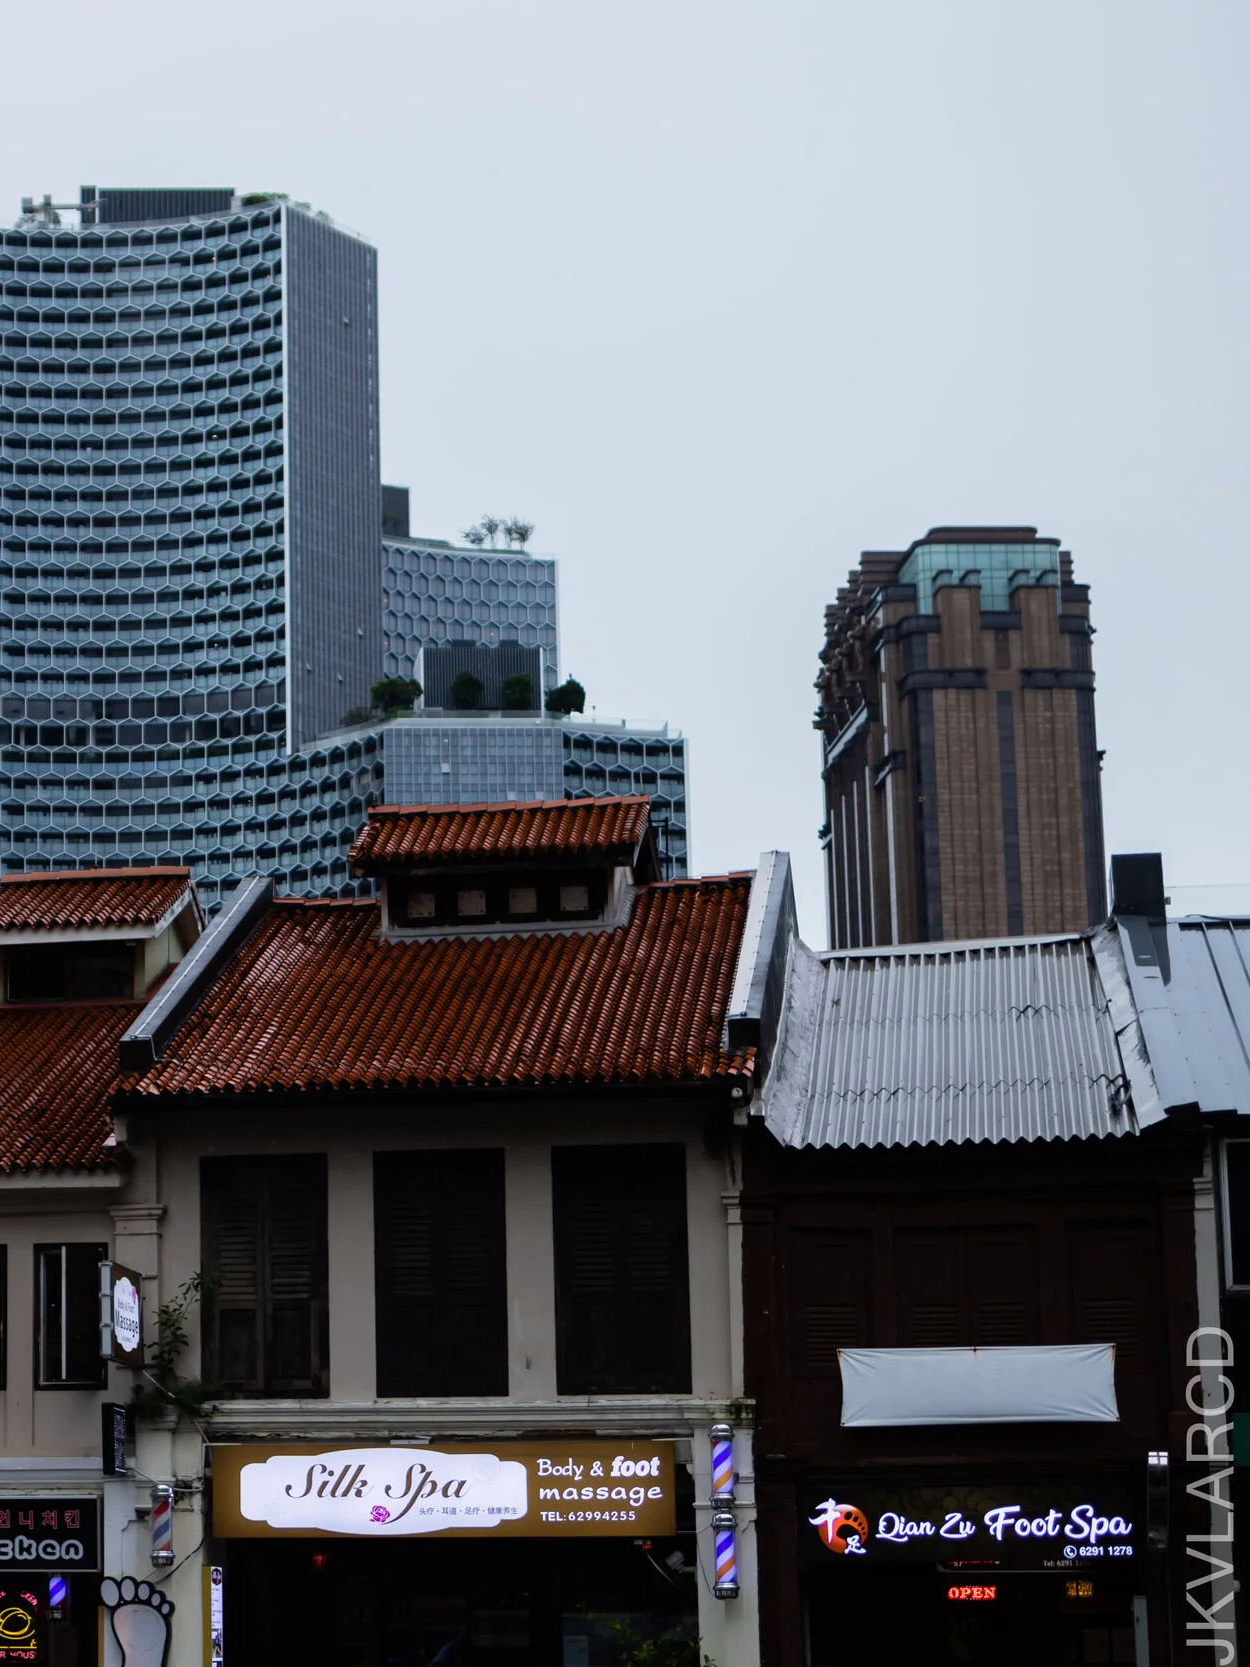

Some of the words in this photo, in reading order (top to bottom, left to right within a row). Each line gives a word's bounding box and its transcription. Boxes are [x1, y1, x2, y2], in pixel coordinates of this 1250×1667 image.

[115, 1308, 139, 1338] Massage
[536, 1457, 584, 1482] Body
[589, 1461, 604, 1477] &
[610, 1455, 661, 1477] foot
[285, 1462, 375, 1499] Silk
[383, 1462, 472, 1525] Spa
[538, 1482, 663, 1507] massage
[875, 1512, 936, 1541] Qian
[939, 1512, 976, 1539] Zu
[984, 1504, 1063, 1540] Foot
[1063, 1503, 1133, 1543] Spa
[1078, 1545, 1105, 1557] 6291
[1107, 1545, 1134, 1557] 1278
[947, 1585, 998, 1601] OPEN
